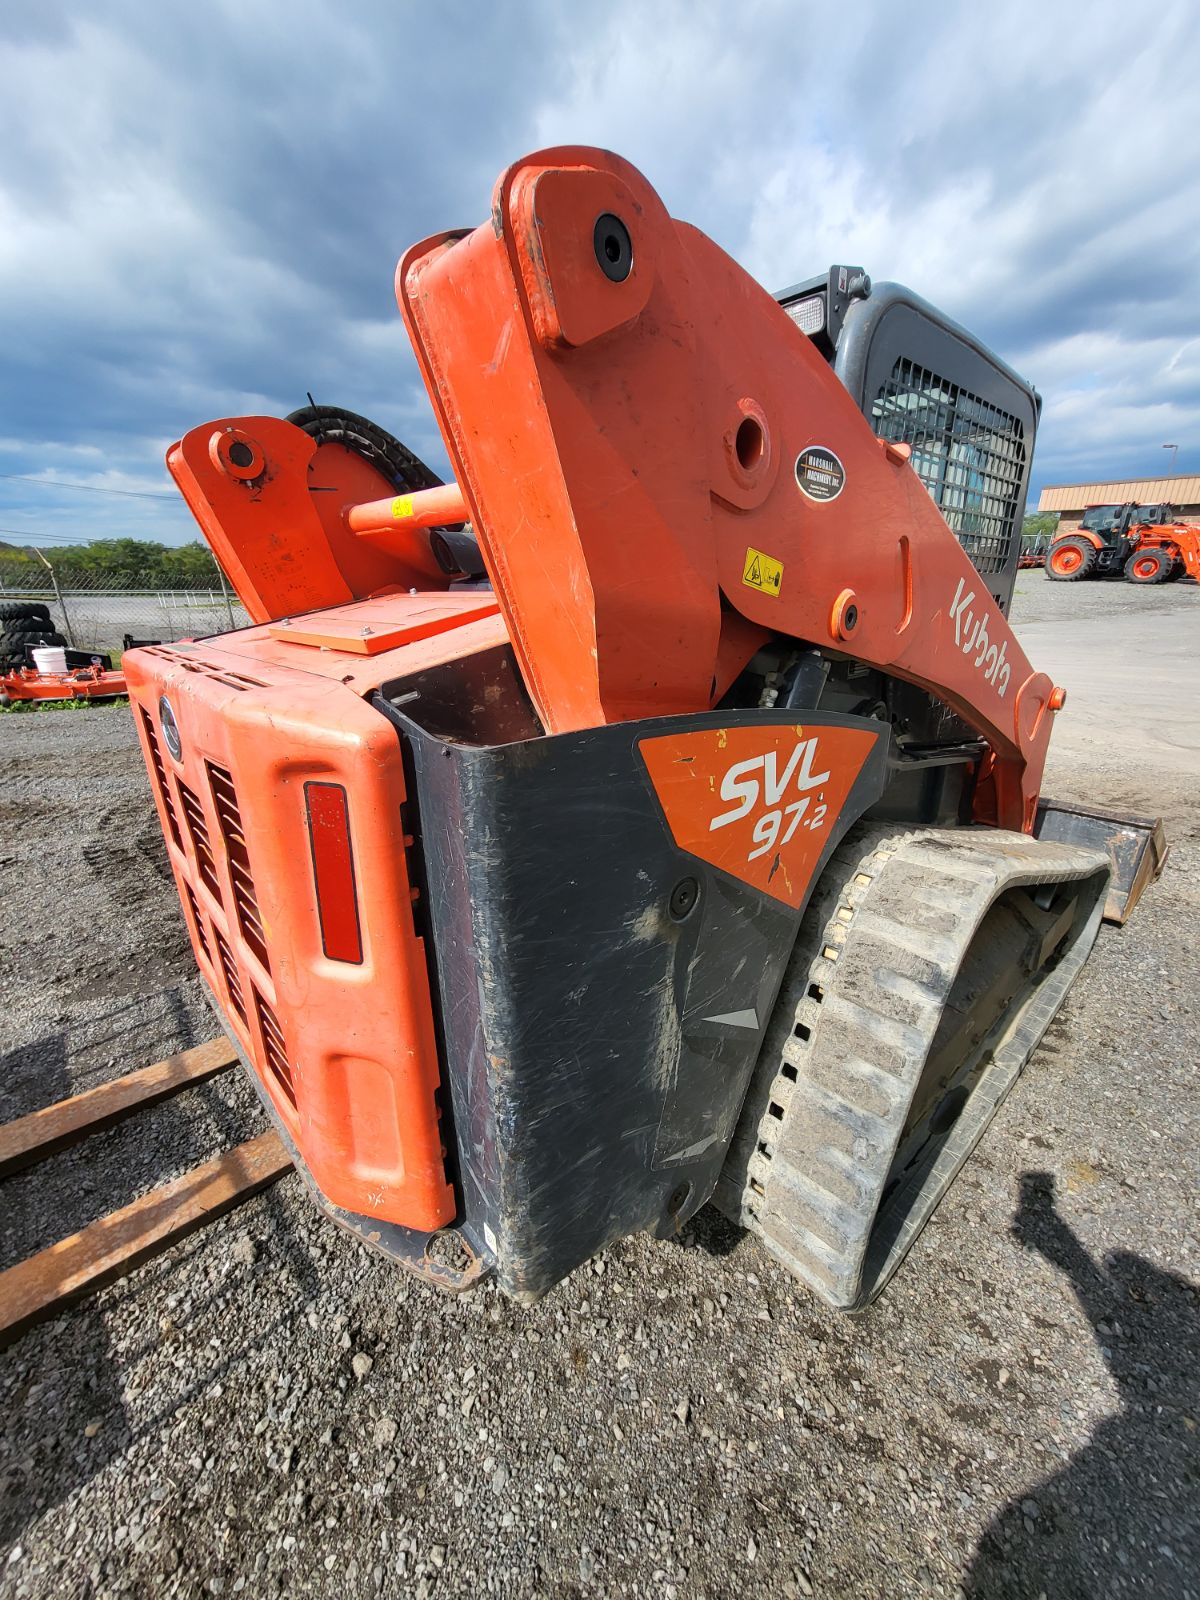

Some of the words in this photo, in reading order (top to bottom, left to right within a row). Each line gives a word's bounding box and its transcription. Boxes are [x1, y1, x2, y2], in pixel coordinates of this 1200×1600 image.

[949, 577, 1010, 697] Kubota
[709, 737, 830, 831] SVL
[748, 796, 827, 862] 97-2
